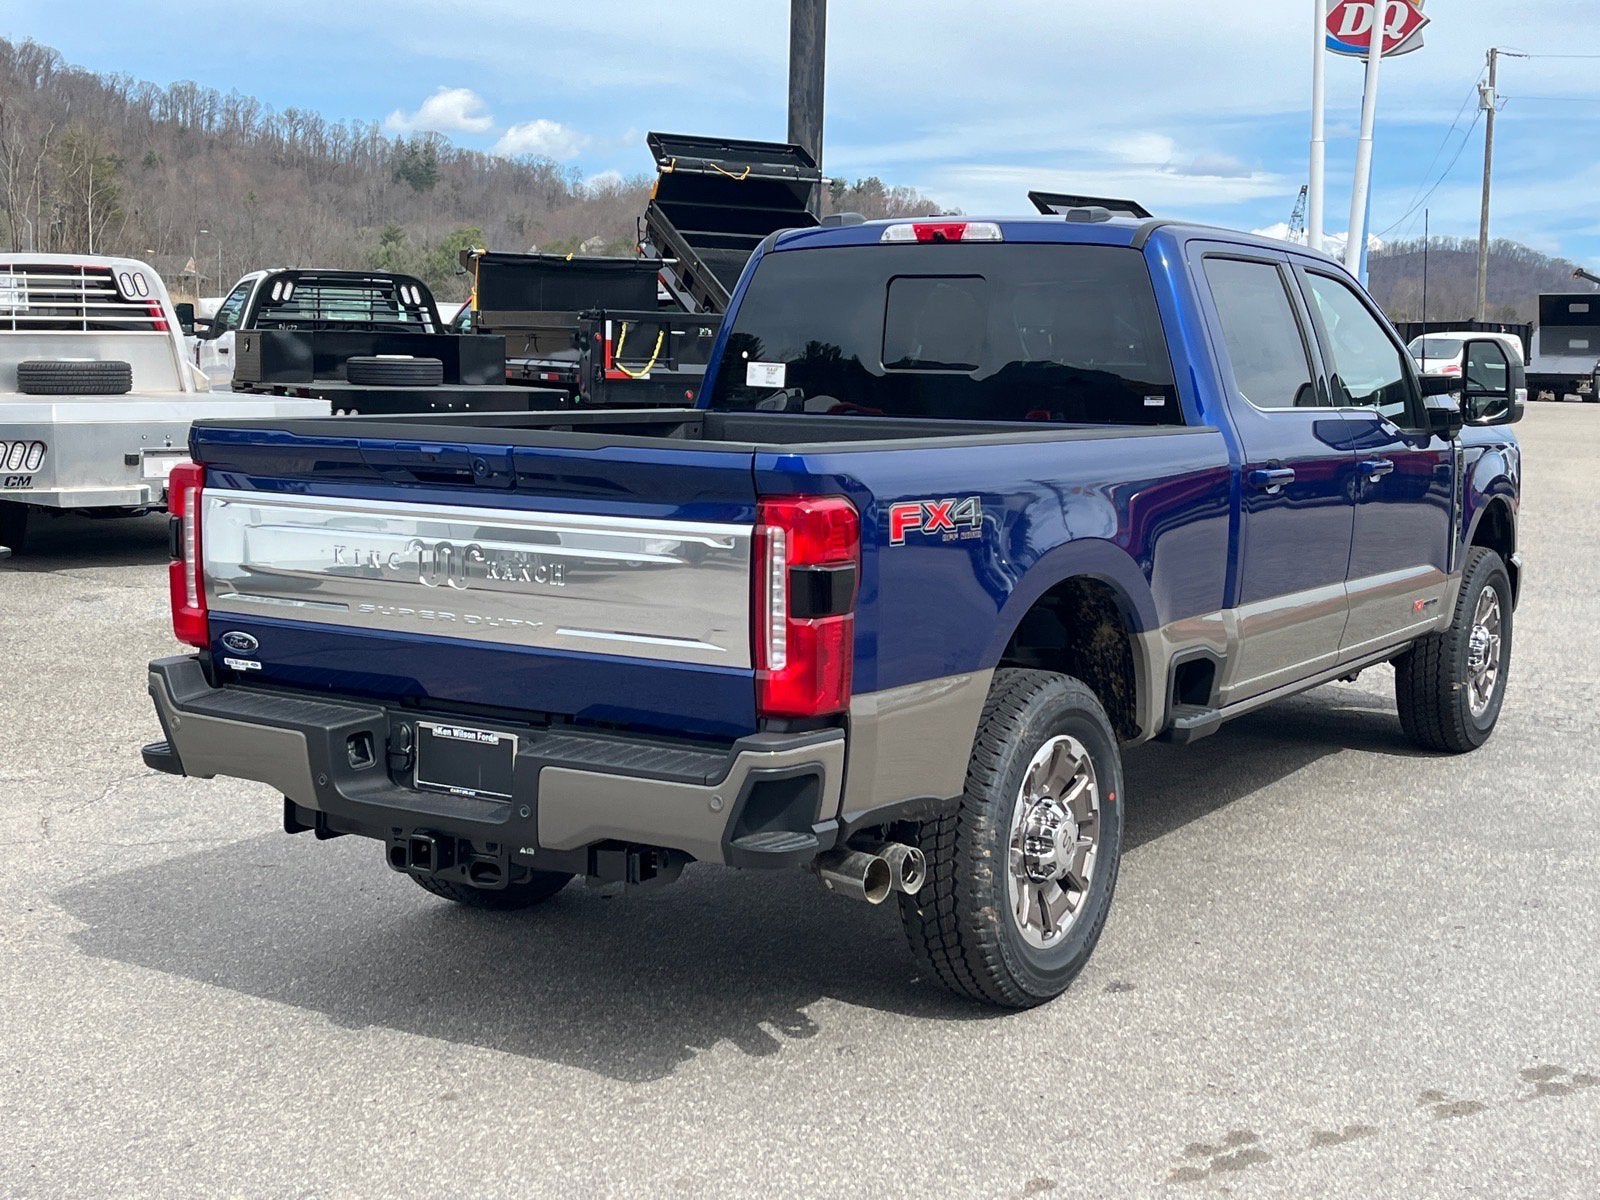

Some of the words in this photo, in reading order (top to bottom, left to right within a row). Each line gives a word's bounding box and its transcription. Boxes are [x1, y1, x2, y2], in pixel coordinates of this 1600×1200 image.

[1337, 1, 1409, 39] DQ
[4, 475, 32, 486] CM
[889, 496, 982, 547] FX4
[333, 544, 401, 571] KING
[486, 561, 566, 587] RANCH
[358, 603, 456, 622] SUPER
[463, 613, 544, 631] DUTY
[229, 635, 249, 649] Ford
[437, 726, 451, 736] Ken
[453, 728, 475, 739] Wilson
[477, 732, 494, 742] Ford
